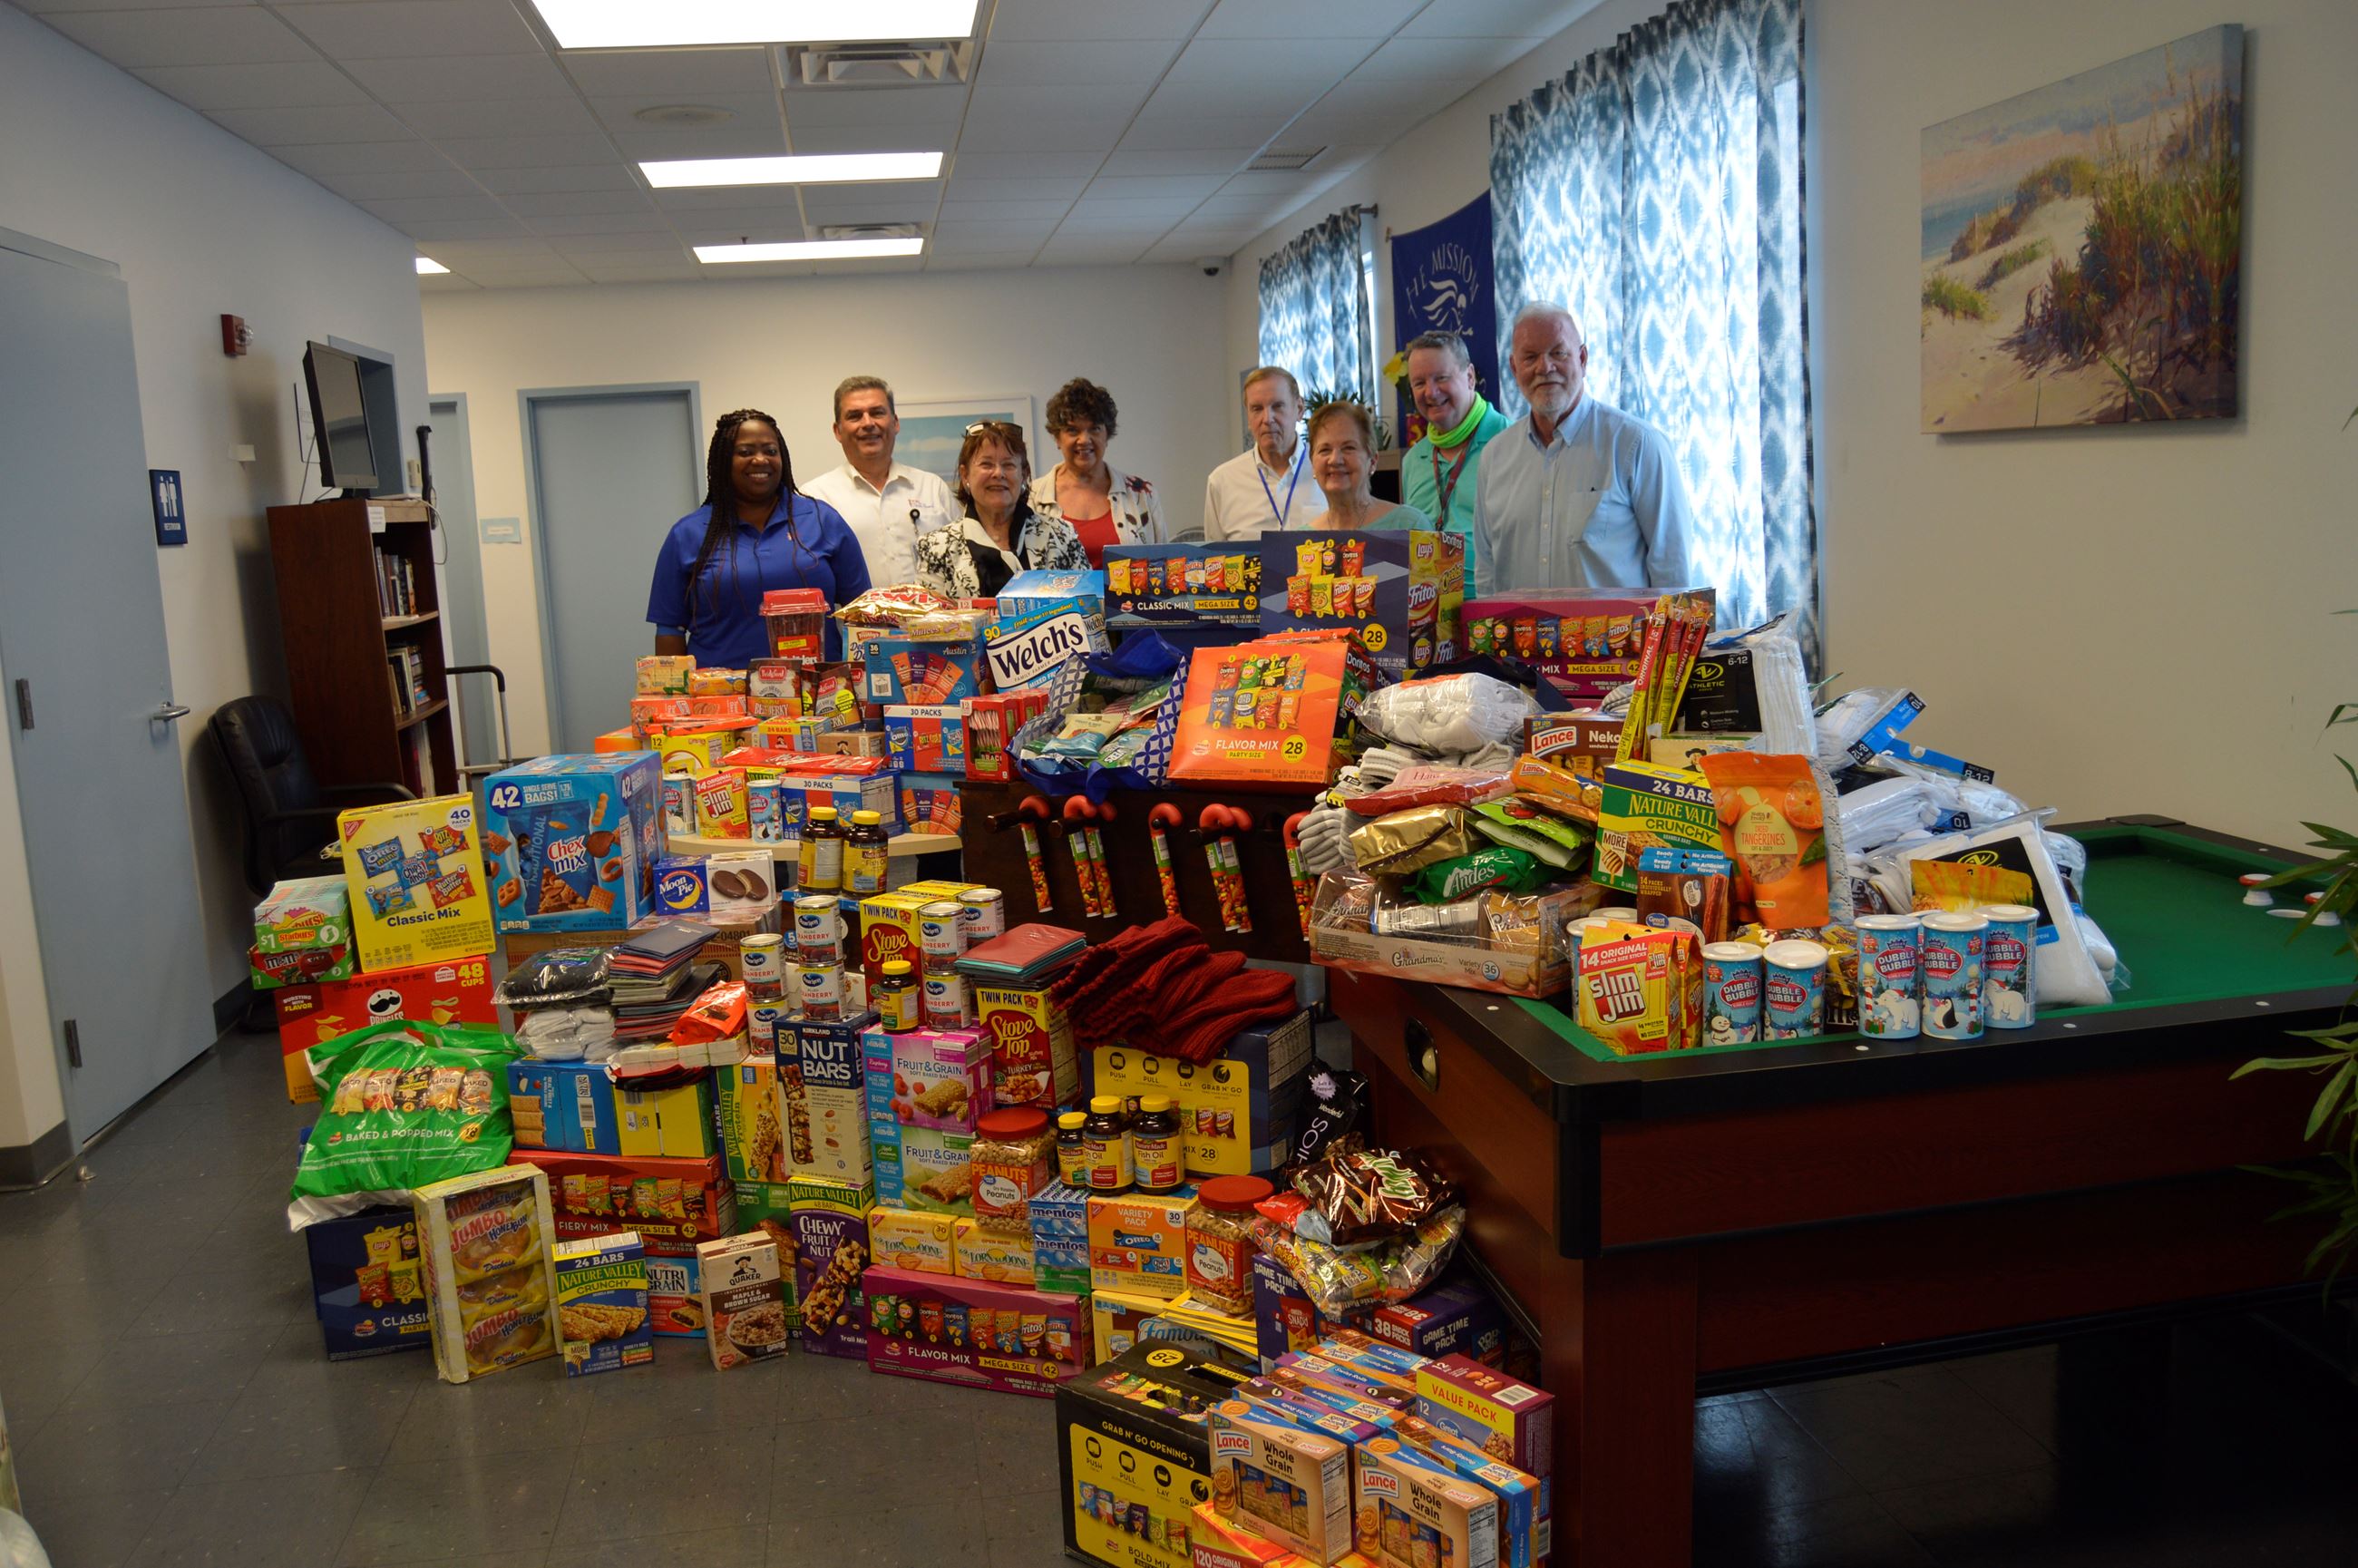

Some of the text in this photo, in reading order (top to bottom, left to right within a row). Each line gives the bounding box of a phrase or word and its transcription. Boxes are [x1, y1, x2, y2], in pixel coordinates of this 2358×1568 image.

[1431, 243, 1479, 304] MISSION
[1137, 601, 1189, 610] CLASSIC MIX
[1244, 599, 1255, 607] 42
[984, 627, 1000, 641] 90
[1367, 630, 1383, 643] 28
[992, 621, 1084, 679] Welch's
[1015, 650, 1070, 682] FAMILY FARMER OWNED
[1637, 645, 1654, 686] ORIGINAL
[1728, 656, 1748, 666] 6-12
[1542, 665, 1560, 674] MIX
[921, 708, 942, 716] PACKS
[652, 737, 662, 746] 12
[1215, 739, 1279, 751] FLAVOR MIX
[1534, 728, 1574, 750] Lance
[1284, 741, 1302, 755] 28
[1964, 770, 1990, 784] 8-12
[814, 781, 833, 789] PACKS
[1653, 780, 1714, 804] 24 BARS
[491, 786, 521, 808] 42
[525, 788, 558, 803] BAGS!
[450, 809, 471, 821] 40
[1645, 818, 1715, 842] CRUNCHY
[1603, 833, 1626, 848] MORE
[1741, 833, 1785, 845] TANGERINES
[527, 815, 546, 888] TRADITIONAL
[548, 835, 588, 860] Chex
[556, 852, 588, 875] mix
[435, 874, 460, 892] Nutter
[659, 876, 687, 895] Moon
[1450, 862, 1496, 894] Andes
[1640, 877, 1648, 886] 14
[677, 881, 694, 896] Pie
[1640, 884, 1671, 892] INDIVIDUALLY
[387, 908, 461, 927] Classic Mix
[863, 904, 899, 920] TWIN PACK
[260, 933, 277, 949] $1
[1392, 952, 1444, 967] Grandma's
[1581, 942, 1647, 969] 14 ORIGINAL
[1629, 951, 1647, 959] STICKS
[1877, 951, 1915, 964] DUBBLE
[458, 963, 484, 978] 48
[1484, 963, 1496, 974] 36
[1880, 958, 1916, 972] BUBBLE
[461, 978, 484, 987] CUPS
[1590, 971, 1639, 999] slim
[1724, 980, 1759, 994] DUBBLE
[283, 995, 312, 1004] BURSTING
[980, 990, 1023, 1006] TWIN PACK
[1725, 988, 1759, 1001] BUBBLE
[285, 1002, 313, 1012] FLAVOR
[779, 1029, 795, 1044] 30
[802, 1039, 848, 1061] NUT
[1006, 1037, 1030, 1059] Top
[803, 1060, 852, 1080] BARS
[1007, 1064, 1032, 1075] TURKEY
[346, 1132, 379, 1142] BAKED
[392, 1129, 433, 1138] POPPED
[435, 1128, 453, 1138] MIX
[1153, 1151, 1164, 1159] Oil
[1201, 1148, 1216, 1158] 28
[971, 1164, 1028, 1180] PEANUTS
[791, 1186, 860, 1210] NATURE VALLEY
[986, 1189, 1016, 1201] Peanuts
[1030, 1207, 1083, 1219] mentos
[1117, 1208, 1153, 1219] VARIETY
[1169, 1213, 1180, 1221] 30
[559, 1222, 609, 1232] FIERY MIX
[799, 1216, 845, 1236] CHEWY
[1125, 1216, 1146, 1227] PACK
[451, 1211, 507, 1251] JUMBO
[684, 1225, 695, 1234] 42
[1035, 1239, 1087, 1251] mentos
[1125, 1235, 1151, 1245] OREO
[1186, 1228, 1234, 1257] PEANUTS
[810, 1245, 832, 1257] NUT
[483, 1259, 516, 1272] Duchess
[575, 1252, 624, 1269] 24 BARS
[1199, 1259, 1223, 1274] Peanuts
[560, 1261, 642, 1290] NATURE VALLEY
[729, 1272, 761, 1286] QUAKER
[577, 1279, 629, 1295] CRUNCHY
[1264, 1279, 1286, 1296] PACK
[724, 1292, 770, 1308] BROWN SUGAR
[1375, 1318, 1391, 1333] 38
[1422, 1317, 1469, 1346] GAME TIME
[1391, 1331, 1411, 1346] PACKS
[1435, 1335, 1457, 1351] PACK
[908, 1347, 970, 1365] FLAVOR MIX
[984, 1359, 1031, 1372] MEGA SIZE
[1044, 1365, 1057, 1374] 42
[1418, 1400, 1429, 1415] 12
[1432, 1383, 1497, 1422] VALUE PACK
[1102, 1421, 1123, 1437] GRAB
[1135, 1434, 1148, 1446] GO
[1150, 1441, 1187, 1461] OPENING
[1216, 1435, 1250, 1449] Lance
[1262, 1439, 1295, 1464] Whole
[1266, 1453, 1293, 1475] Grain
[1363, 1475, 1397, 1490] Lance
[1410, 1482, 1442, 1509] Whole
[1413, 1498, 1440, 1521] Grain
[1128, 1546, 1172, 1568] BOLD MIX
